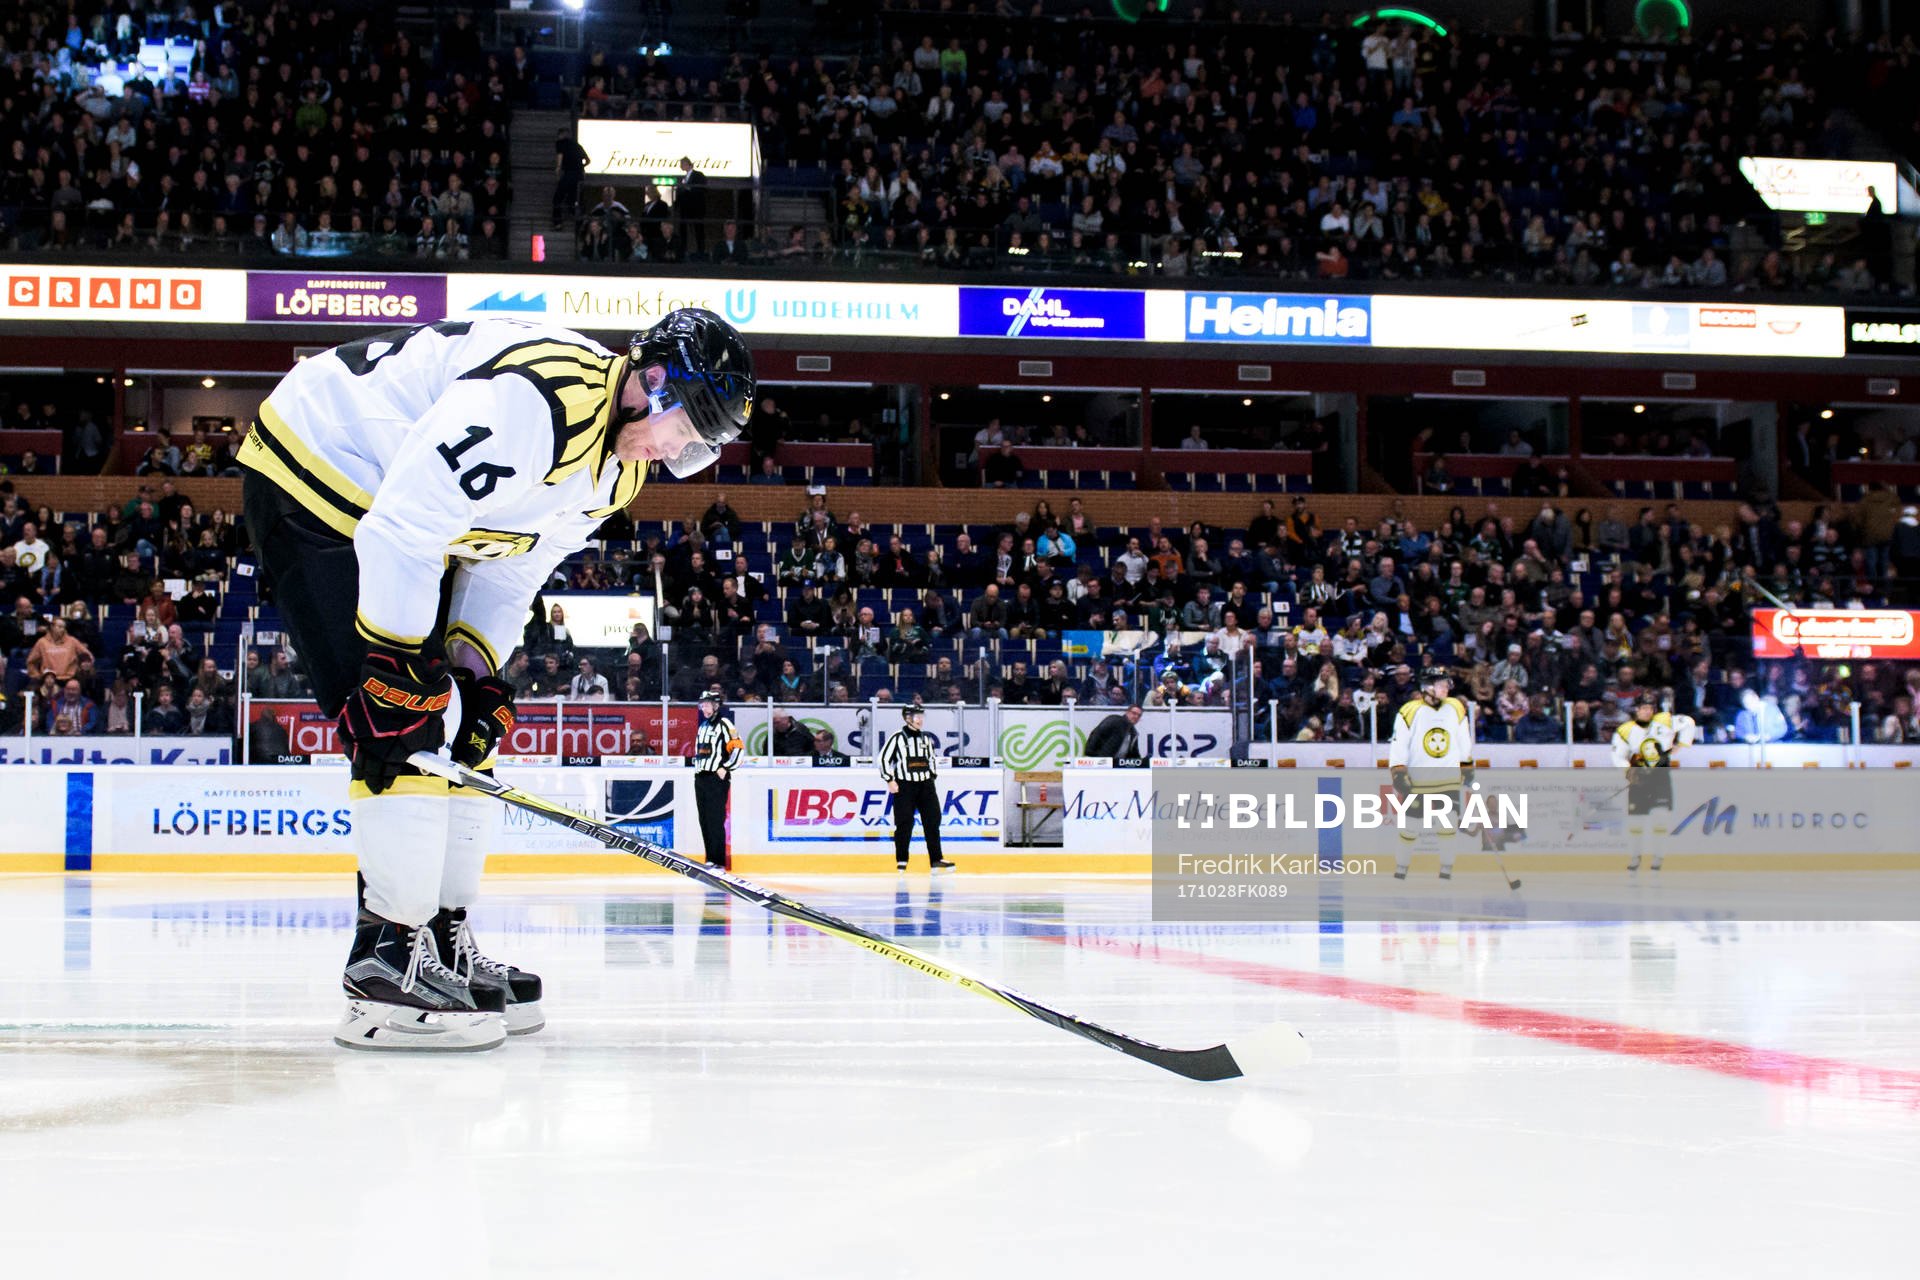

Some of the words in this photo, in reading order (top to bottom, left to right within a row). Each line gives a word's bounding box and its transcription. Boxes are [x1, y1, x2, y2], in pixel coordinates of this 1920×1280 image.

[12, 279, 198, 306] CRAMO
[275, 290, 418, 317] LÖFBERGS
[563, 290, 712, 317] Munkfors
[772, 299, 919, 321] UDDEHOLM
[1002, 297, 1071, 317] DAHL
[1189, 295, 1368, 337] Helmia
[436, 425, 516, 501] 16
[362, 677, 453, 712] BAUE
[278, 755, 303, 763] DAKO
[569, 756, 593, 765] DAKO
[819, 757, 843, 765] DAKO
[958, 758, 982, 766] DAKO
[1118, 758, 1142, 767] DAKO
[1237, 759, 1261, 767] DAKO
[784, 788, 858, 826] LBC
[860, 789, 1000, 816] FKT
[152, 802, 352, 836] LÖFBERGS
[1751, 812, 1870, 830] MIDROC
